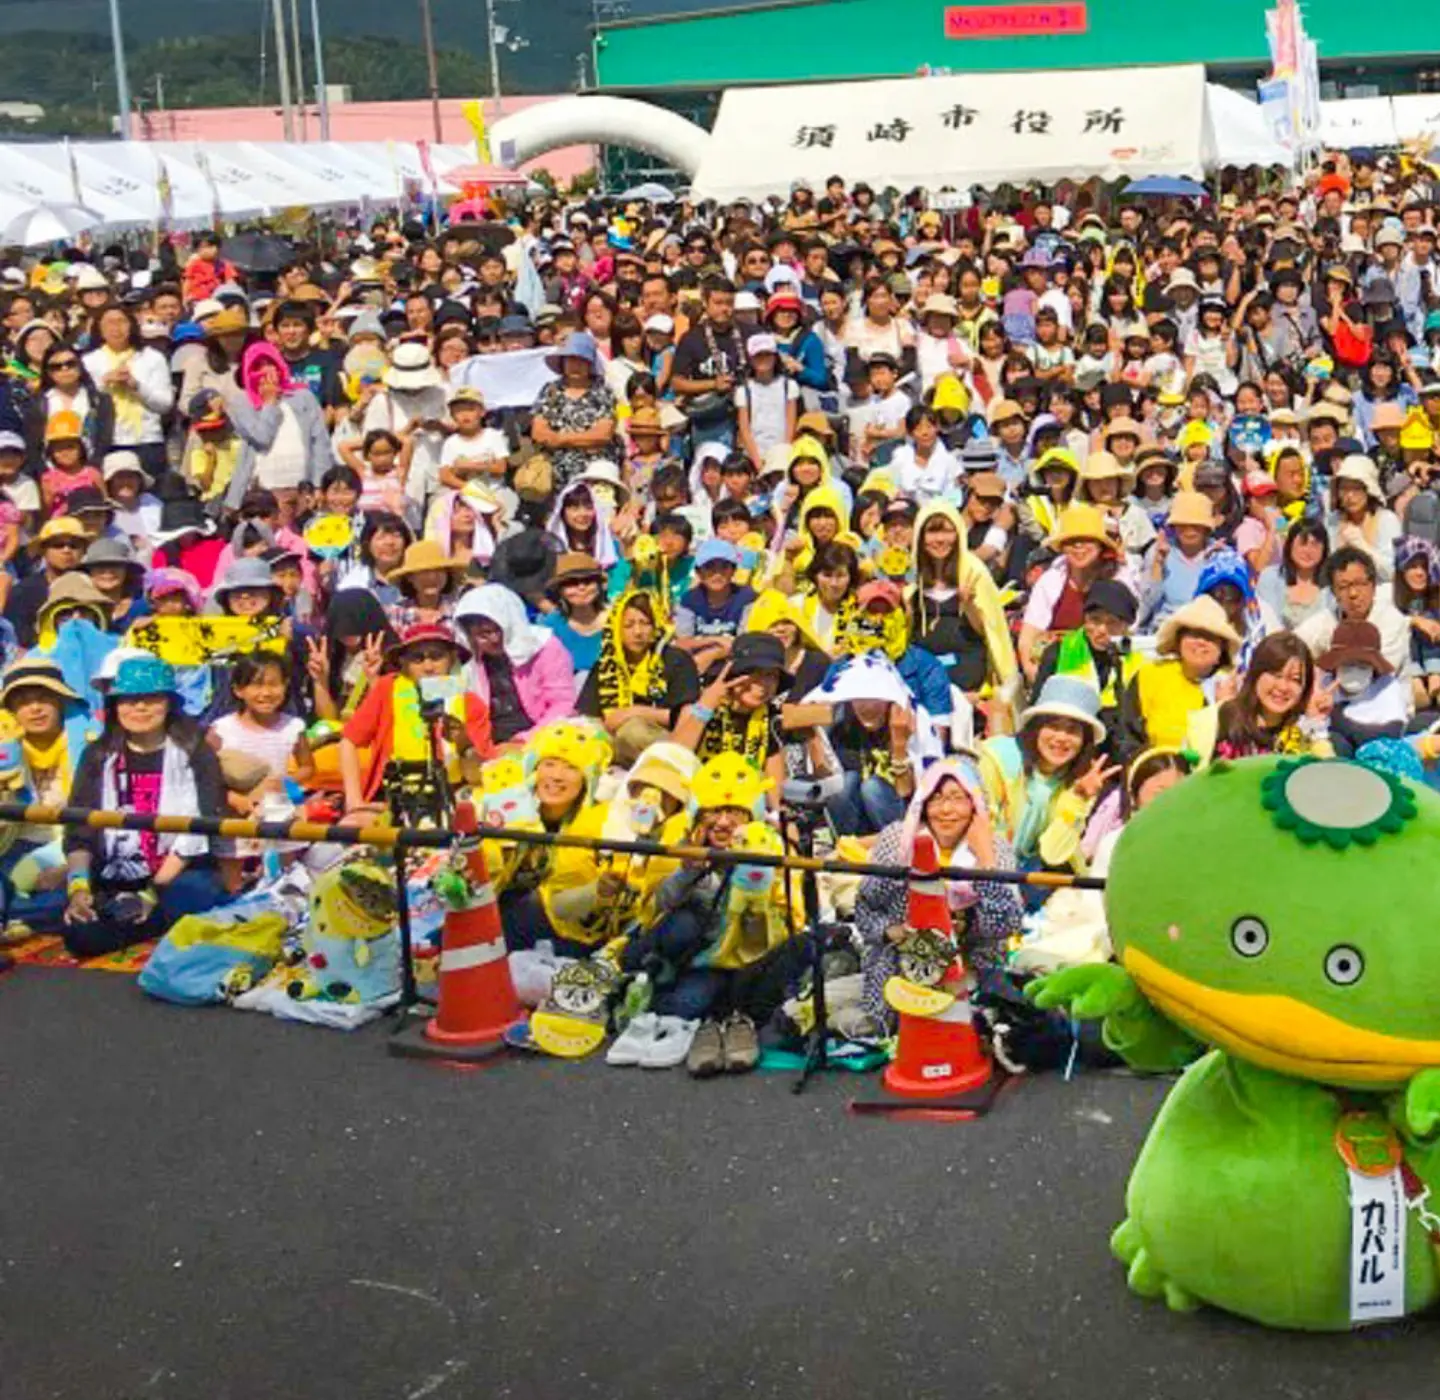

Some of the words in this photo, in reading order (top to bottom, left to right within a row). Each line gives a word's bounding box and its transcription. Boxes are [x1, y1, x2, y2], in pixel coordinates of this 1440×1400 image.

[791, 104, 1126, 149] 須崎市役所
[1359, 1198, 1387, 1284] カパル
